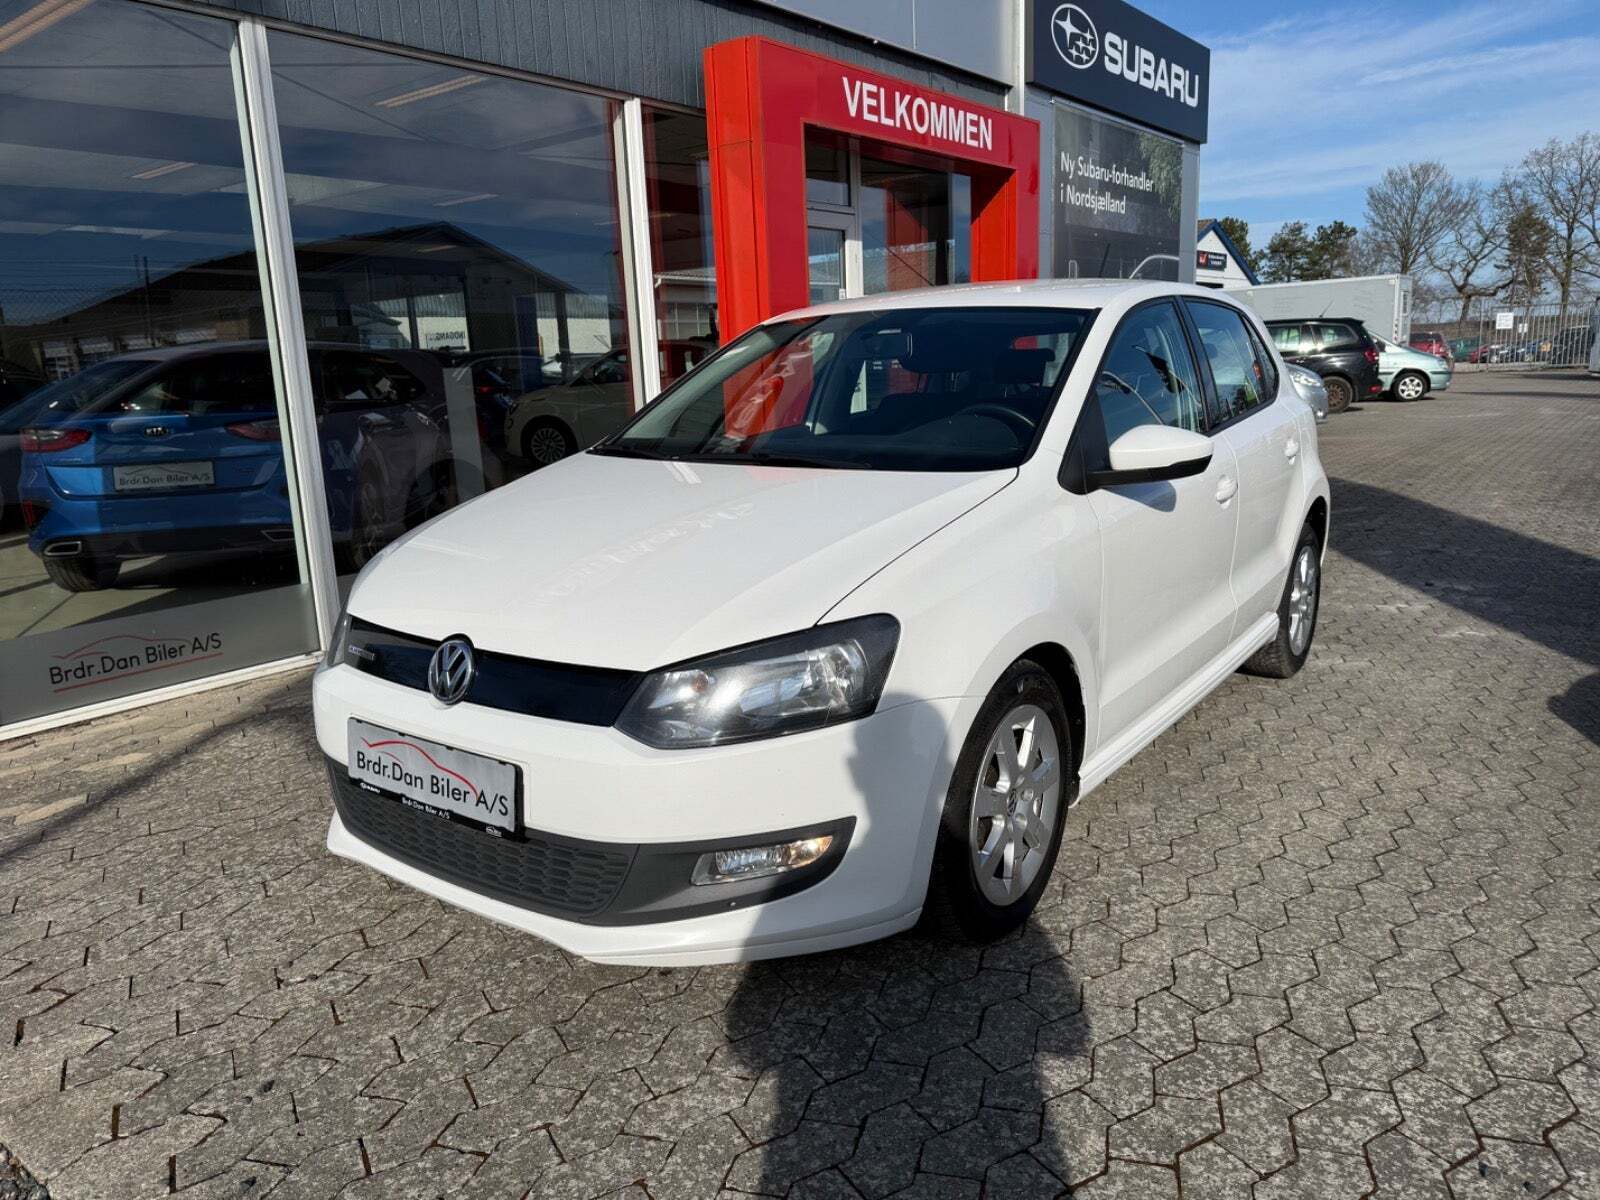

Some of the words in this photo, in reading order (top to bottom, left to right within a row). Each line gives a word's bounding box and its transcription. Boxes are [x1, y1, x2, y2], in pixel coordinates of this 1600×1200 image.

[1103, 30, 1200, 108] SUBARU
[842, 76, 994, 151] VELKOMMEN
[1060, 151, 1076, 180] Ny
[1078, 156, 1154, 192] Subaru-forhandler
[1066, 184, 1126, 214] Nordsjælland
[166, 474, 190, 483] Biler
[191, 471, 210, 481] A/S
[50, 655, 140, 685] Brdr.Dan
[146, 642, 186, 666] Biler
[191, 633, 223, 653] A/S
[356, 750, 424, 791] Brdr.Dan
[430, 775, 470, 804] Biler
[475, 789, 509, 817] A/S
